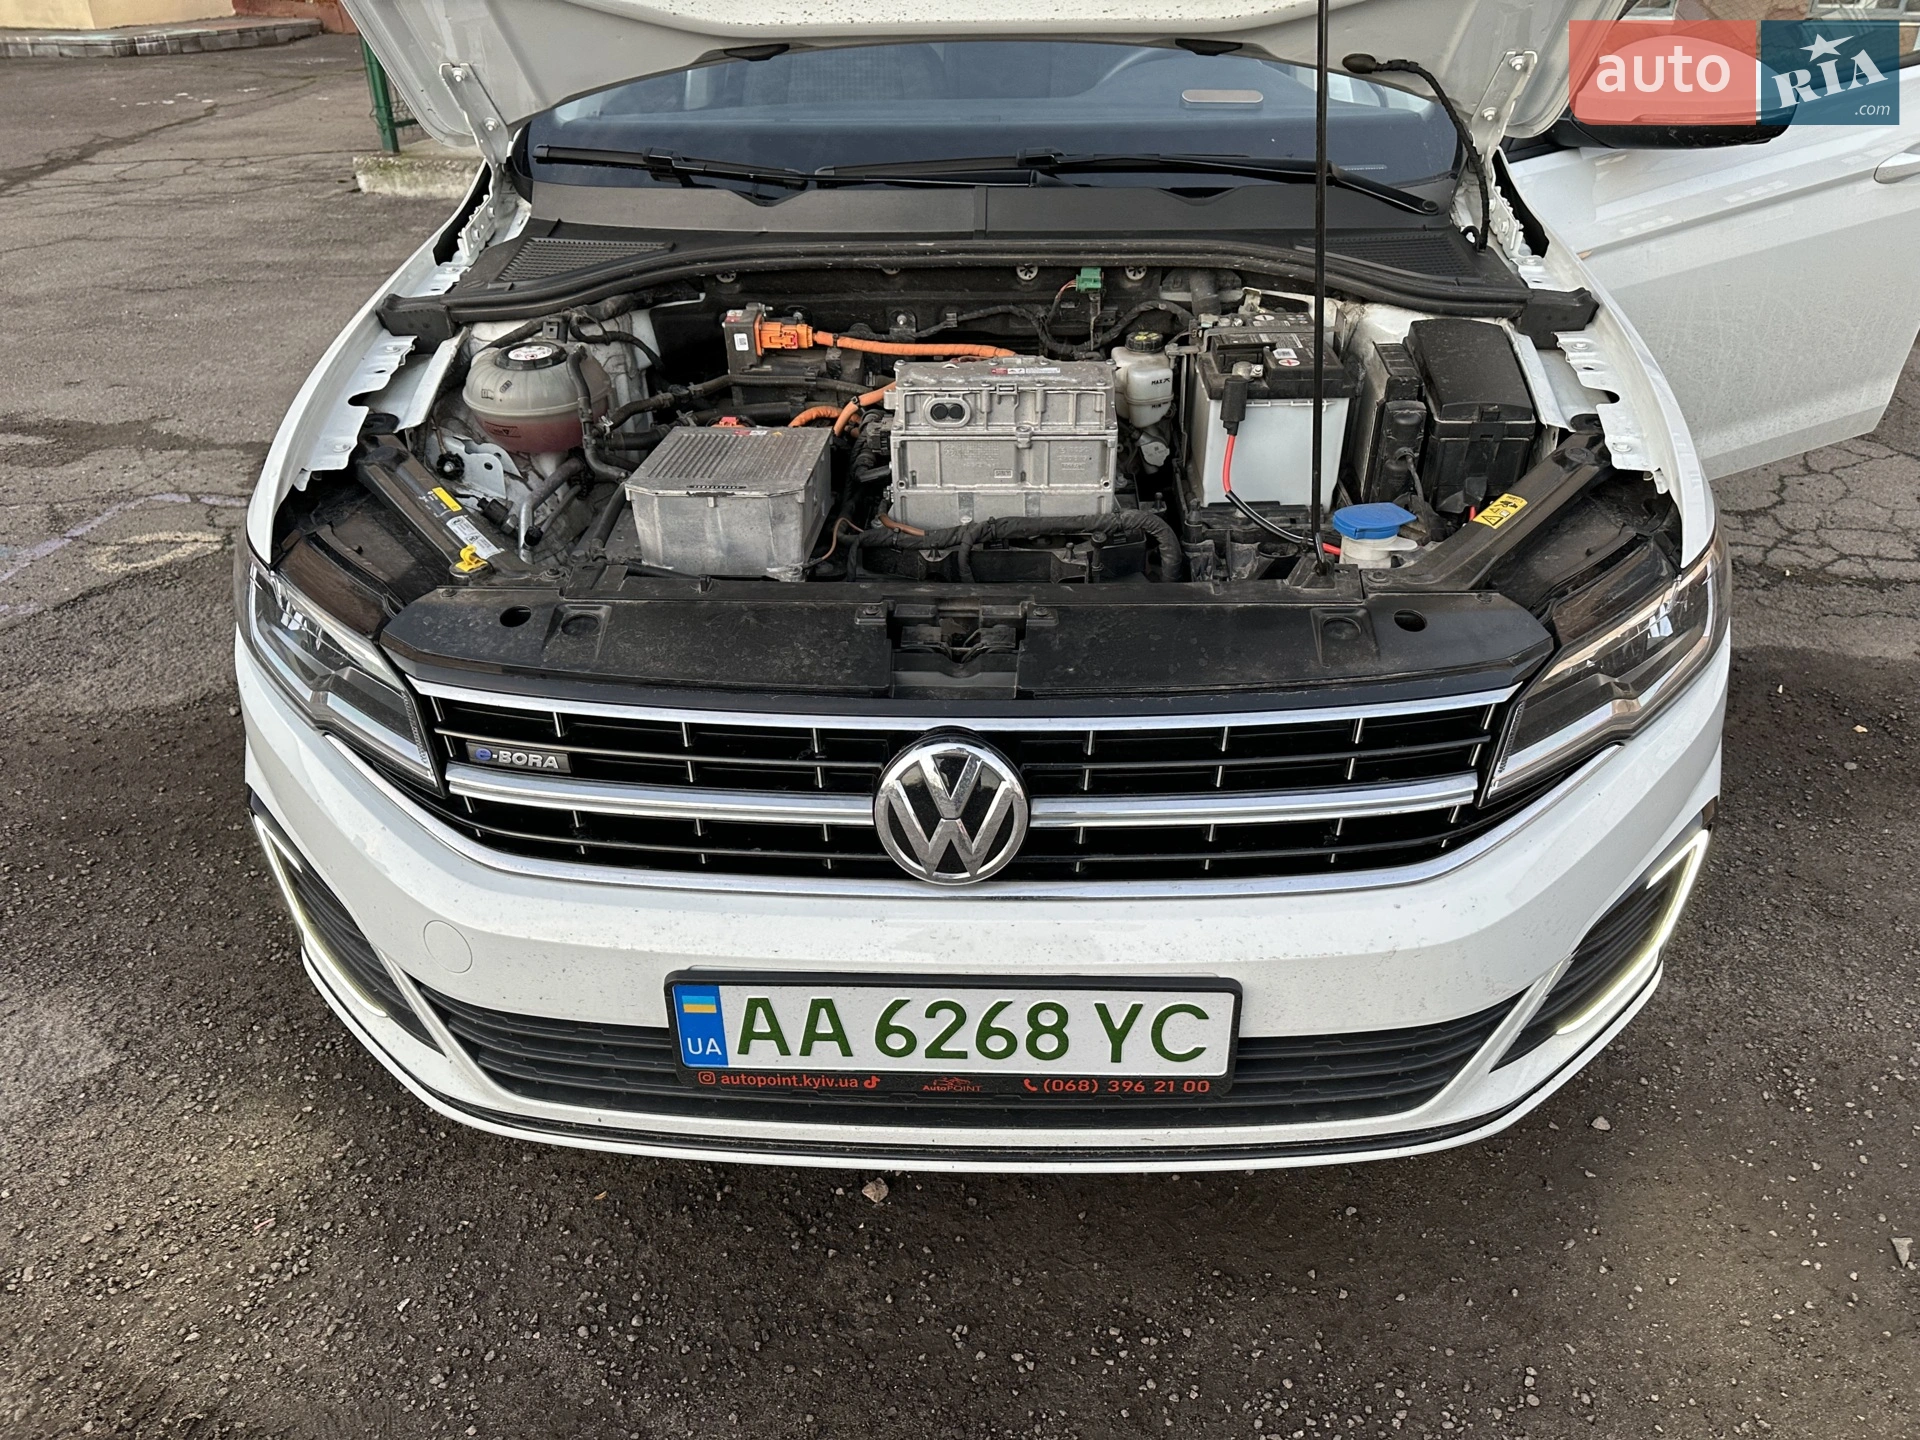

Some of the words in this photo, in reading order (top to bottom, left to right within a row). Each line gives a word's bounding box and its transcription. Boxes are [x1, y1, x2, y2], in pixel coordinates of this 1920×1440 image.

[737, 997, 853, 1057] AA
[874, 1000, 1070, 1061] 6268
[1095, 1002, 1210, 1063] YC
[687, 1037, 722, 1056] UA
[721, 1074, 859, 1089] autopoint.kyiv.ua
[1043, 1079, 1099, 1093] (068)
[1107, 1080, 1146, 1093] 396
[1153, 1080, 1175, 1093] 21
[1183, 1080, 1210, 1093] 00
